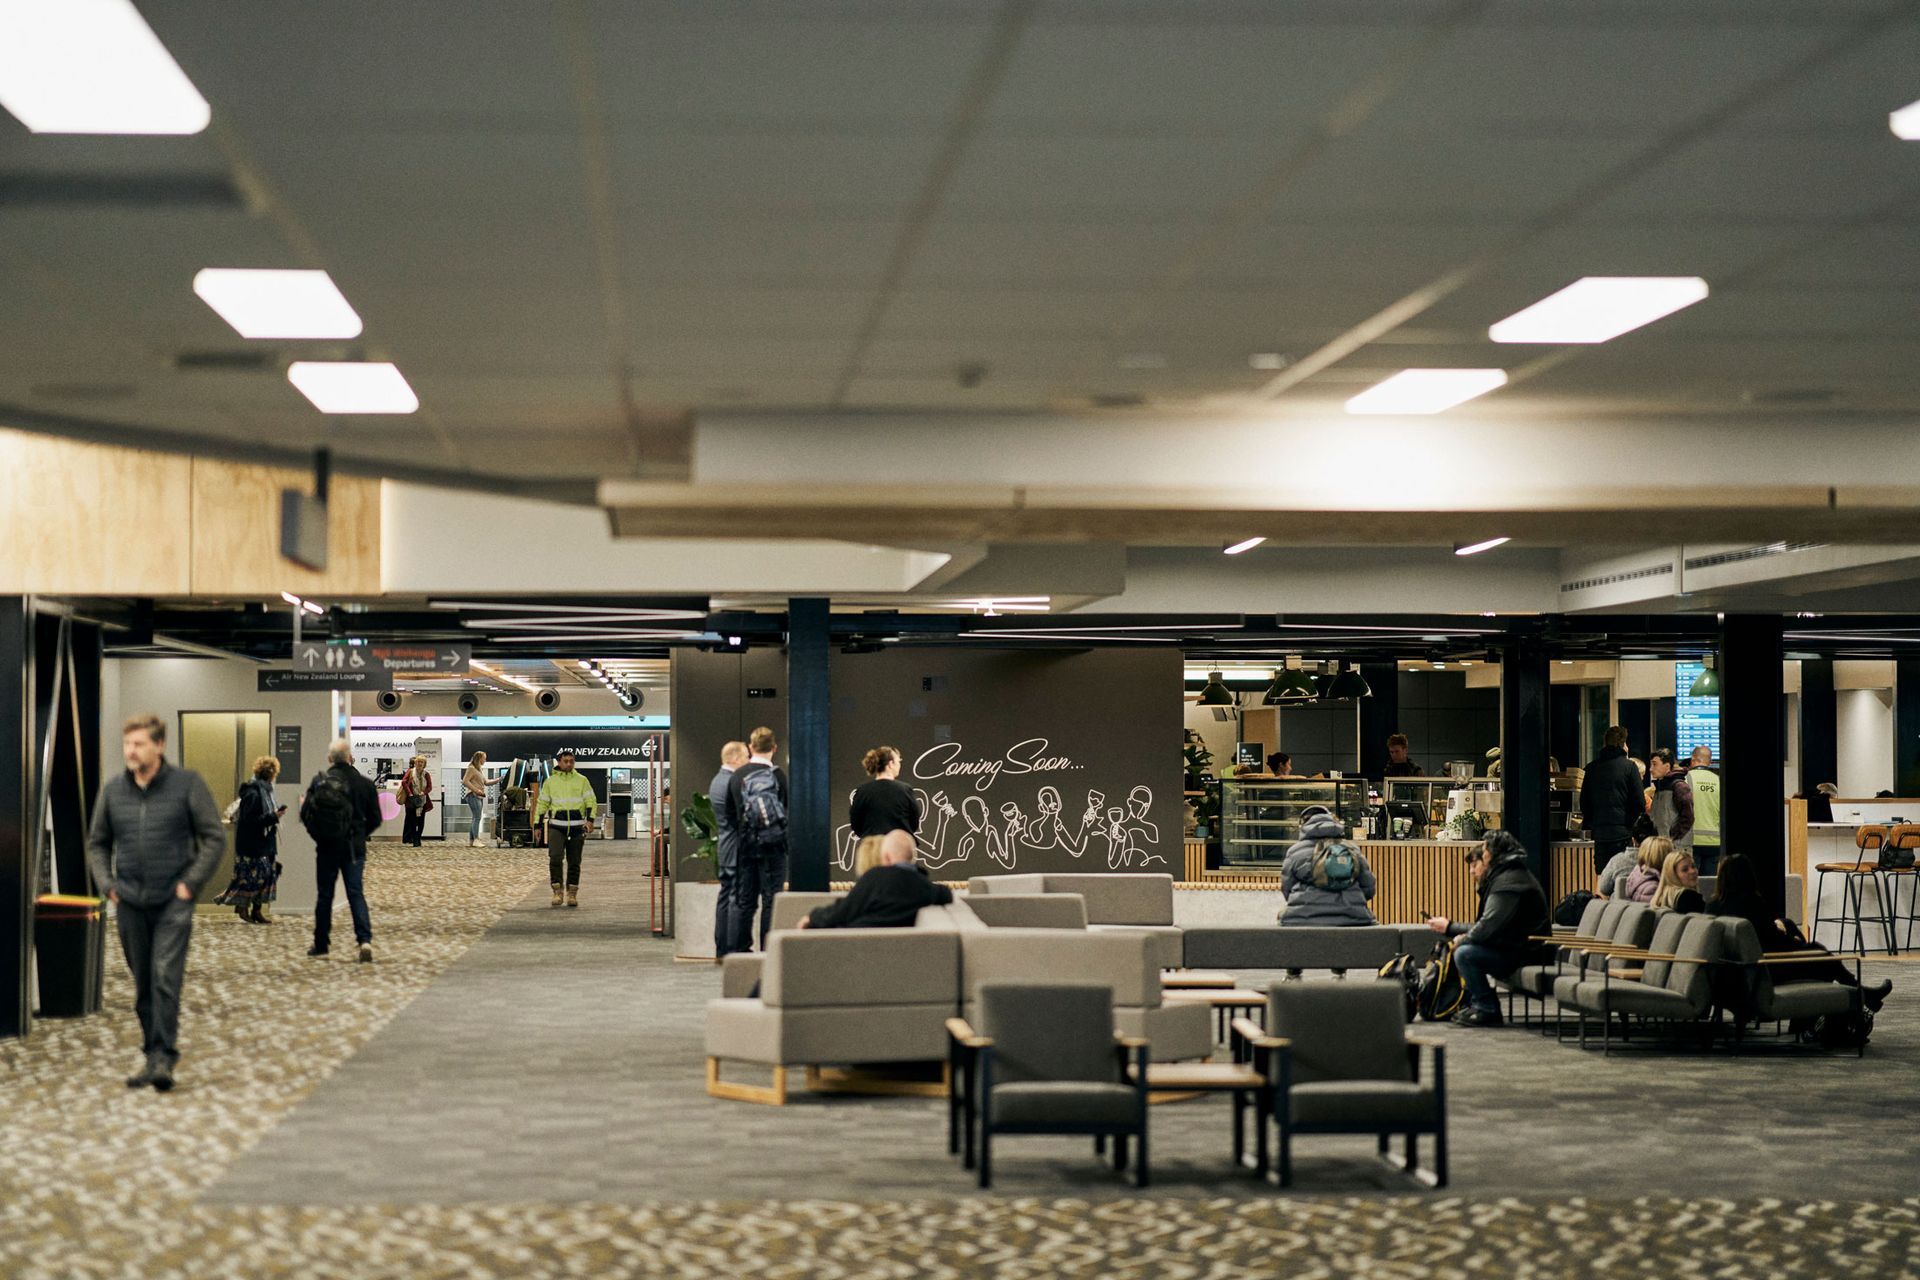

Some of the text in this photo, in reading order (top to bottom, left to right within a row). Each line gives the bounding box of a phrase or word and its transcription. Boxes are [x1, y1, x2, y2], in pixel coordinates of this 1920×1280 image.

[384, 659, 436, 670] Departures
[281, 671, 366, 682] Air New Zealand Lounge
[575, 747, 597, 755] NEW
[597, 747, 640, 755] ZEALAND
[913, 738, 1084, 792] Coming Soon...
[1700, 785, 1715, 793] OPS
